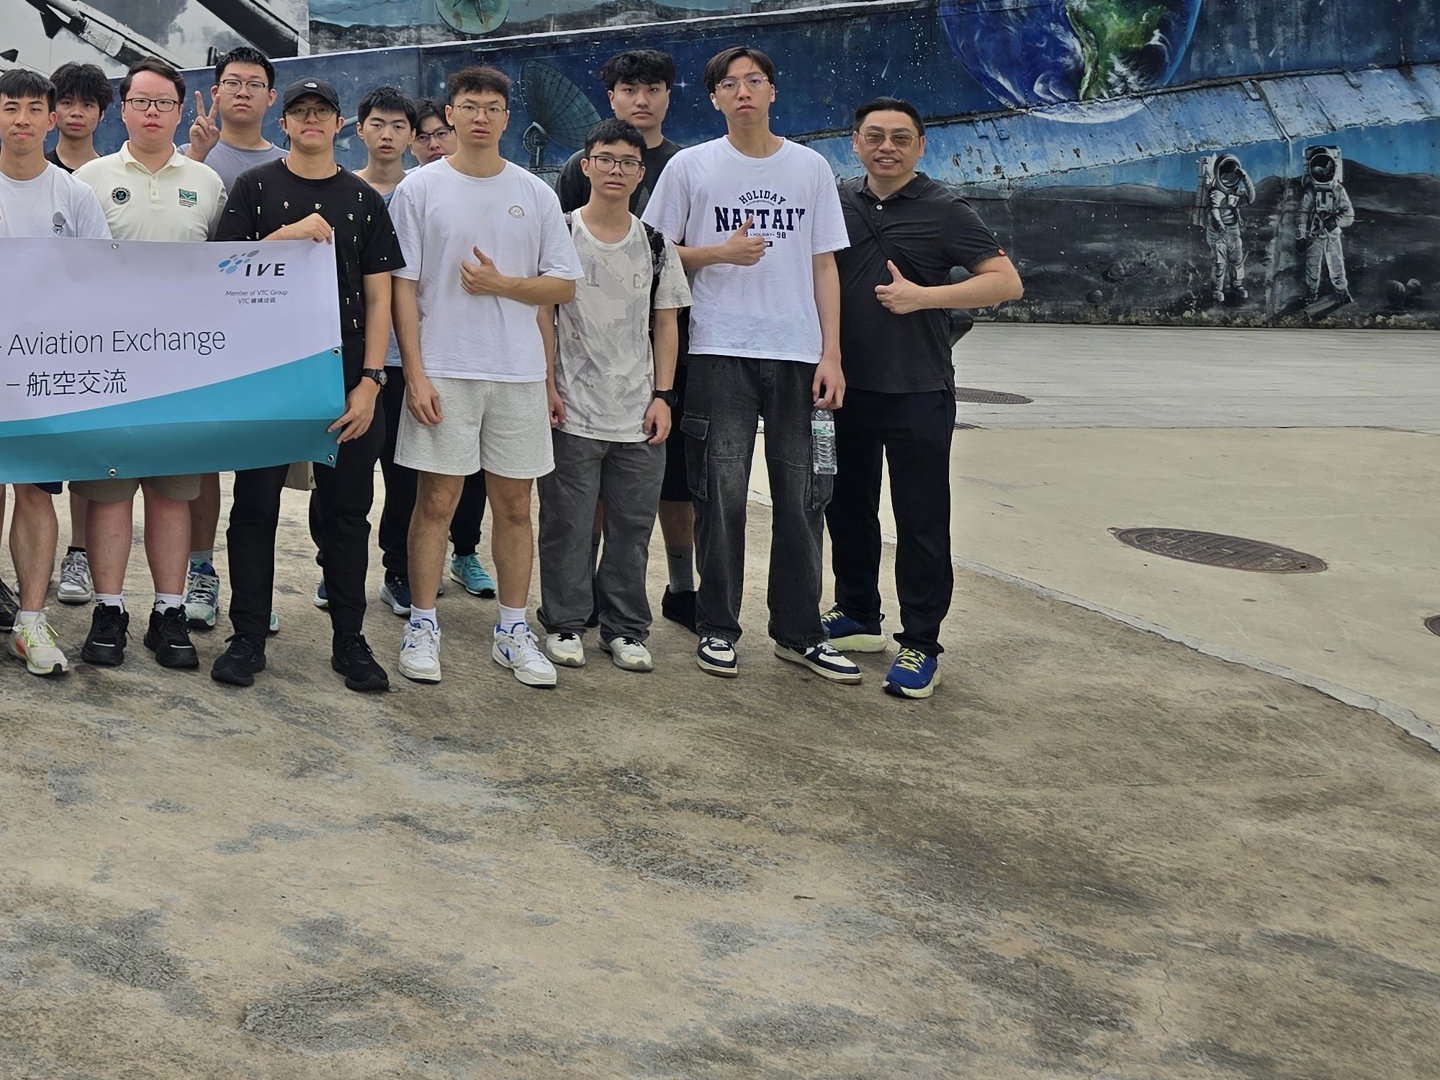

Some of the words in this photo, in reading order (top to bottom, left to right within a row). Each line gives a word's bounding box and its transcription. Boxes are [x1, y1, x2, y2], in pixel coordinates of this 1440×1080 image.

[738, 189, 787, 206] HOLIDAY
[245, 262, 286, 277] IVE
[7, 330, 103, 356] Aviation
[112, 327, 226, 356] Exchange
[27, 368, 128, 397] 航空交流
